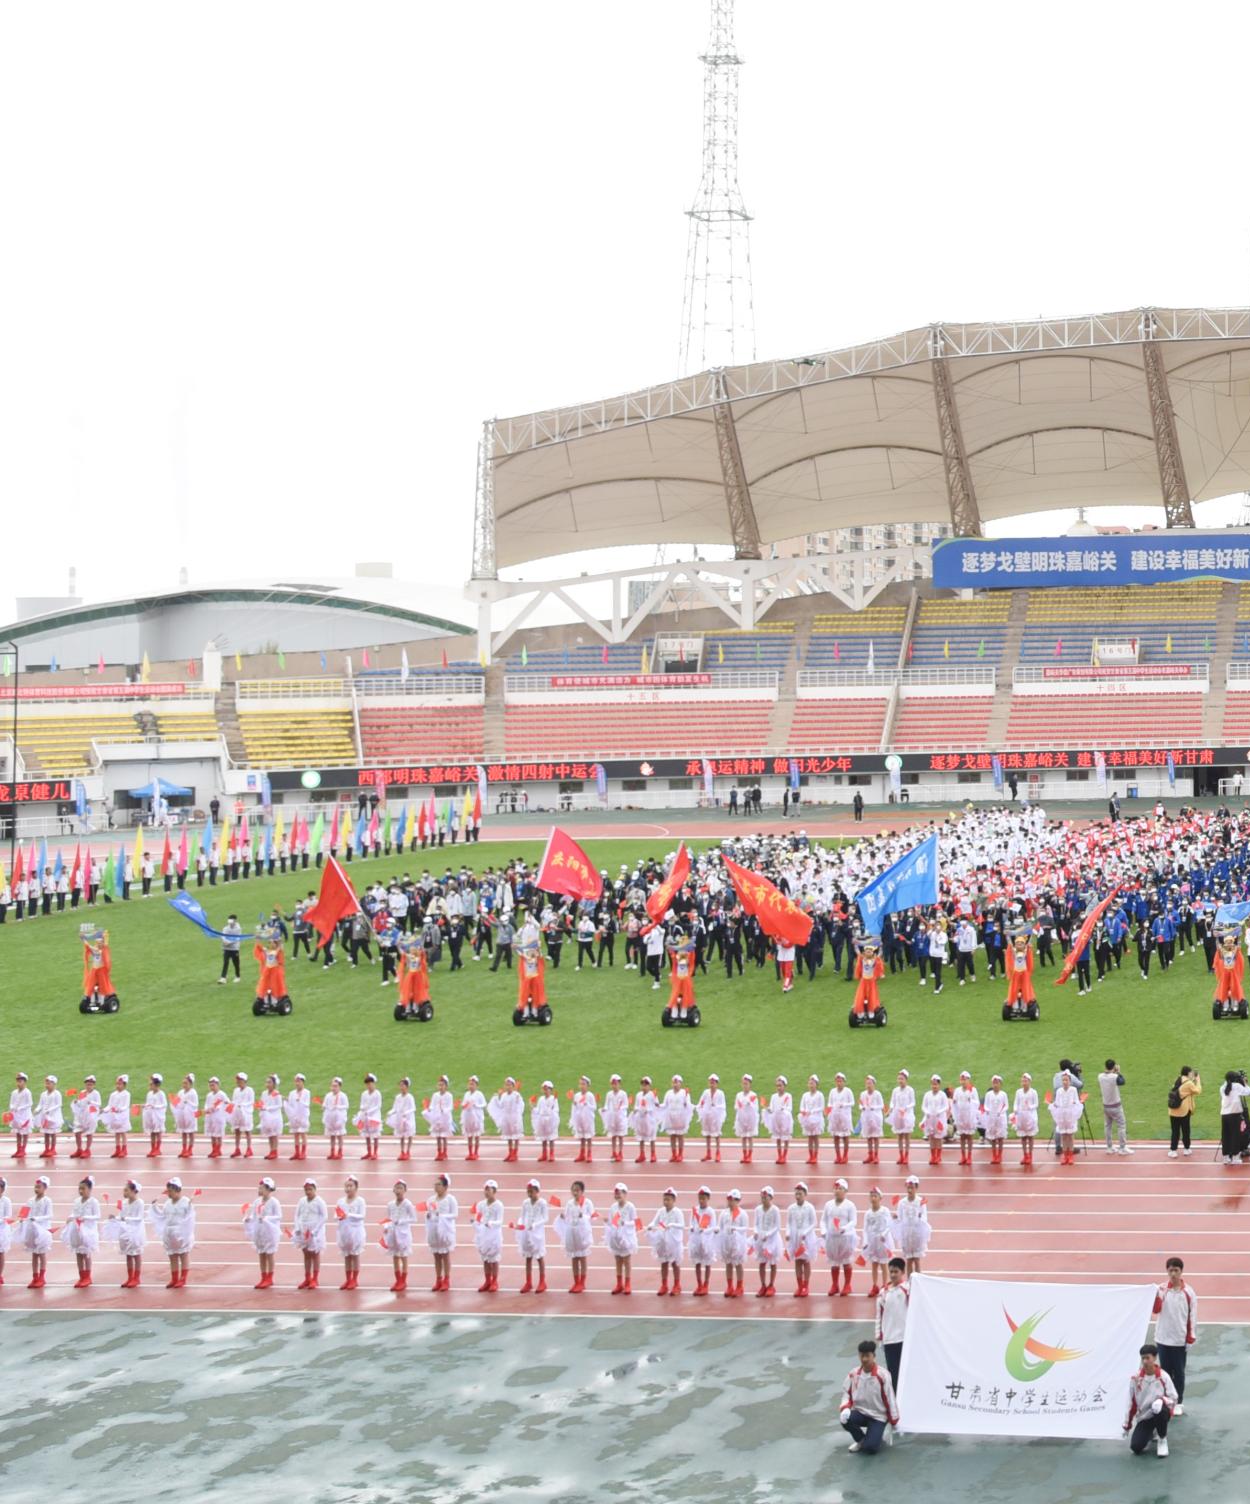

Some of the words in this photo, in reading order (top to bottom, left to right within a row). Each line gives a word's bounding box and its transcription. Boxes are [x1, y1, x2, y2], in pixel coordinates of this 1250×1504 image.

[962, 550, 1117, 572] 逐梦戈壁明珠嘉峪关
[945, 1381, 1108, 1409] 甘肃省中学生运动会
[941, 1398, 967, 1410] Gansu
[968, 1403, 1011, 1415] Secondary
[1013, 1407, 1041, 1415] School
[1042, 1405, 1078, 1415] Students
[1079, 1403, 1107, 1412] Games
